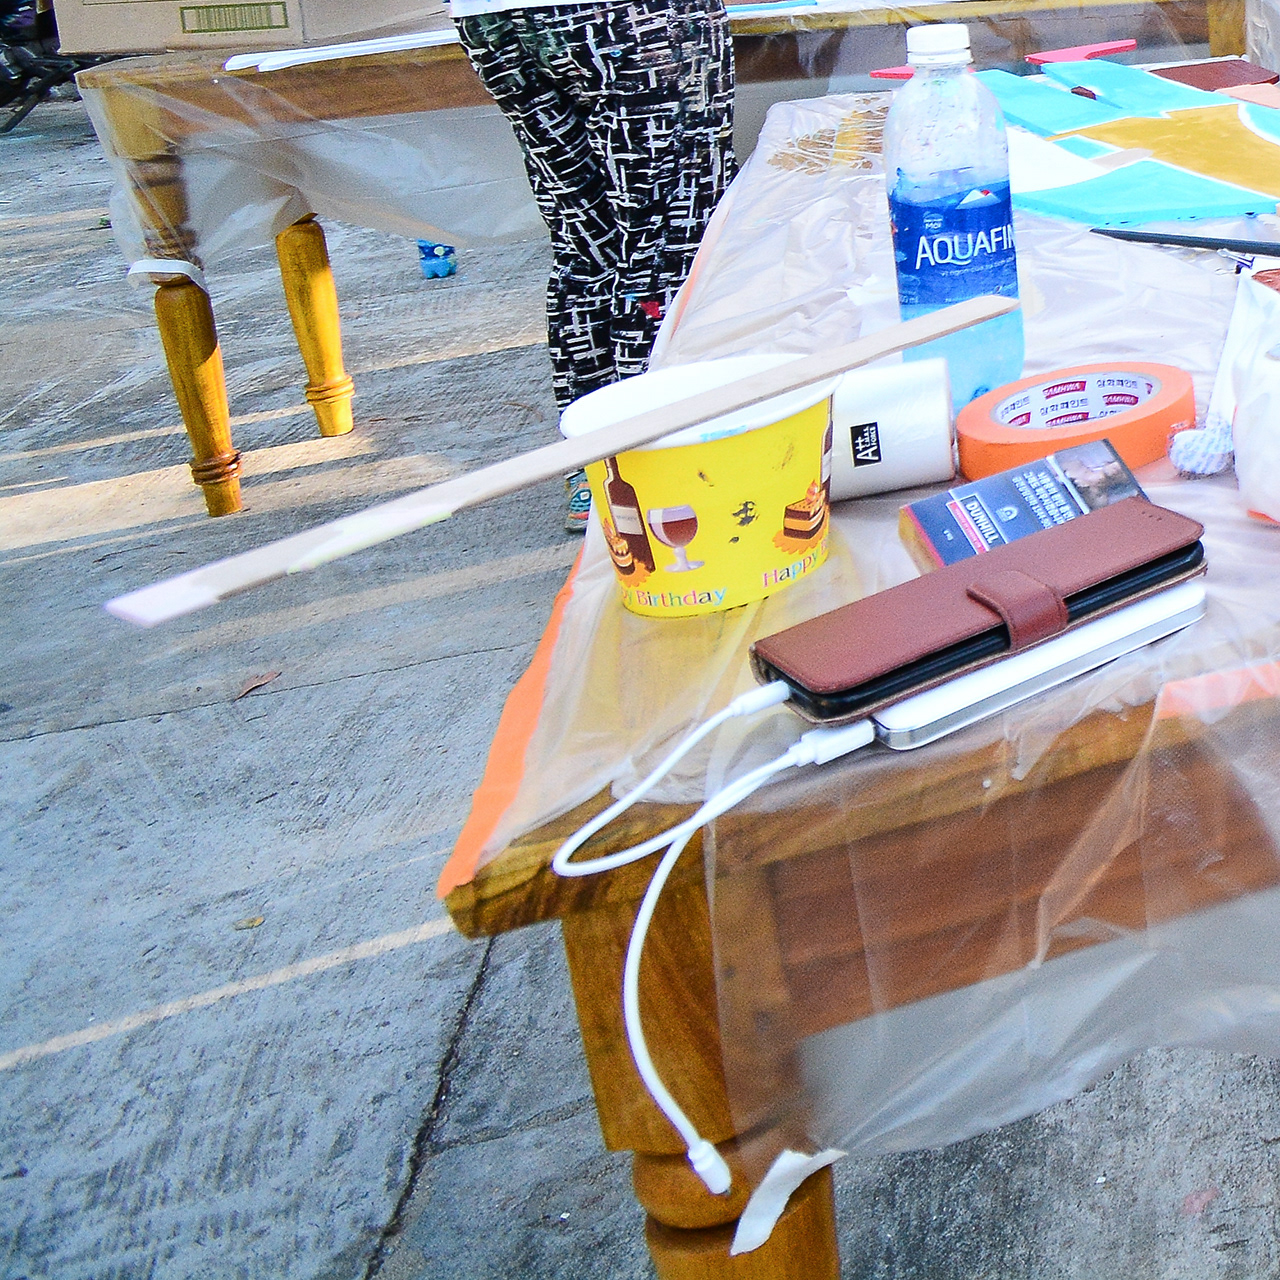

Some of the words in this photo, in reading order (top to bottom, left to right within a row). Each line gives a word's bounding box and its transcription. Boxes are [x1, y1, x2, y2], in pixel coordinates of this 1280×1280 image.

[965, 500, 1000, 544] DUNHILL
[763, 550, 818, 588] Happy
[636, 586, 728, 608] Birthday
